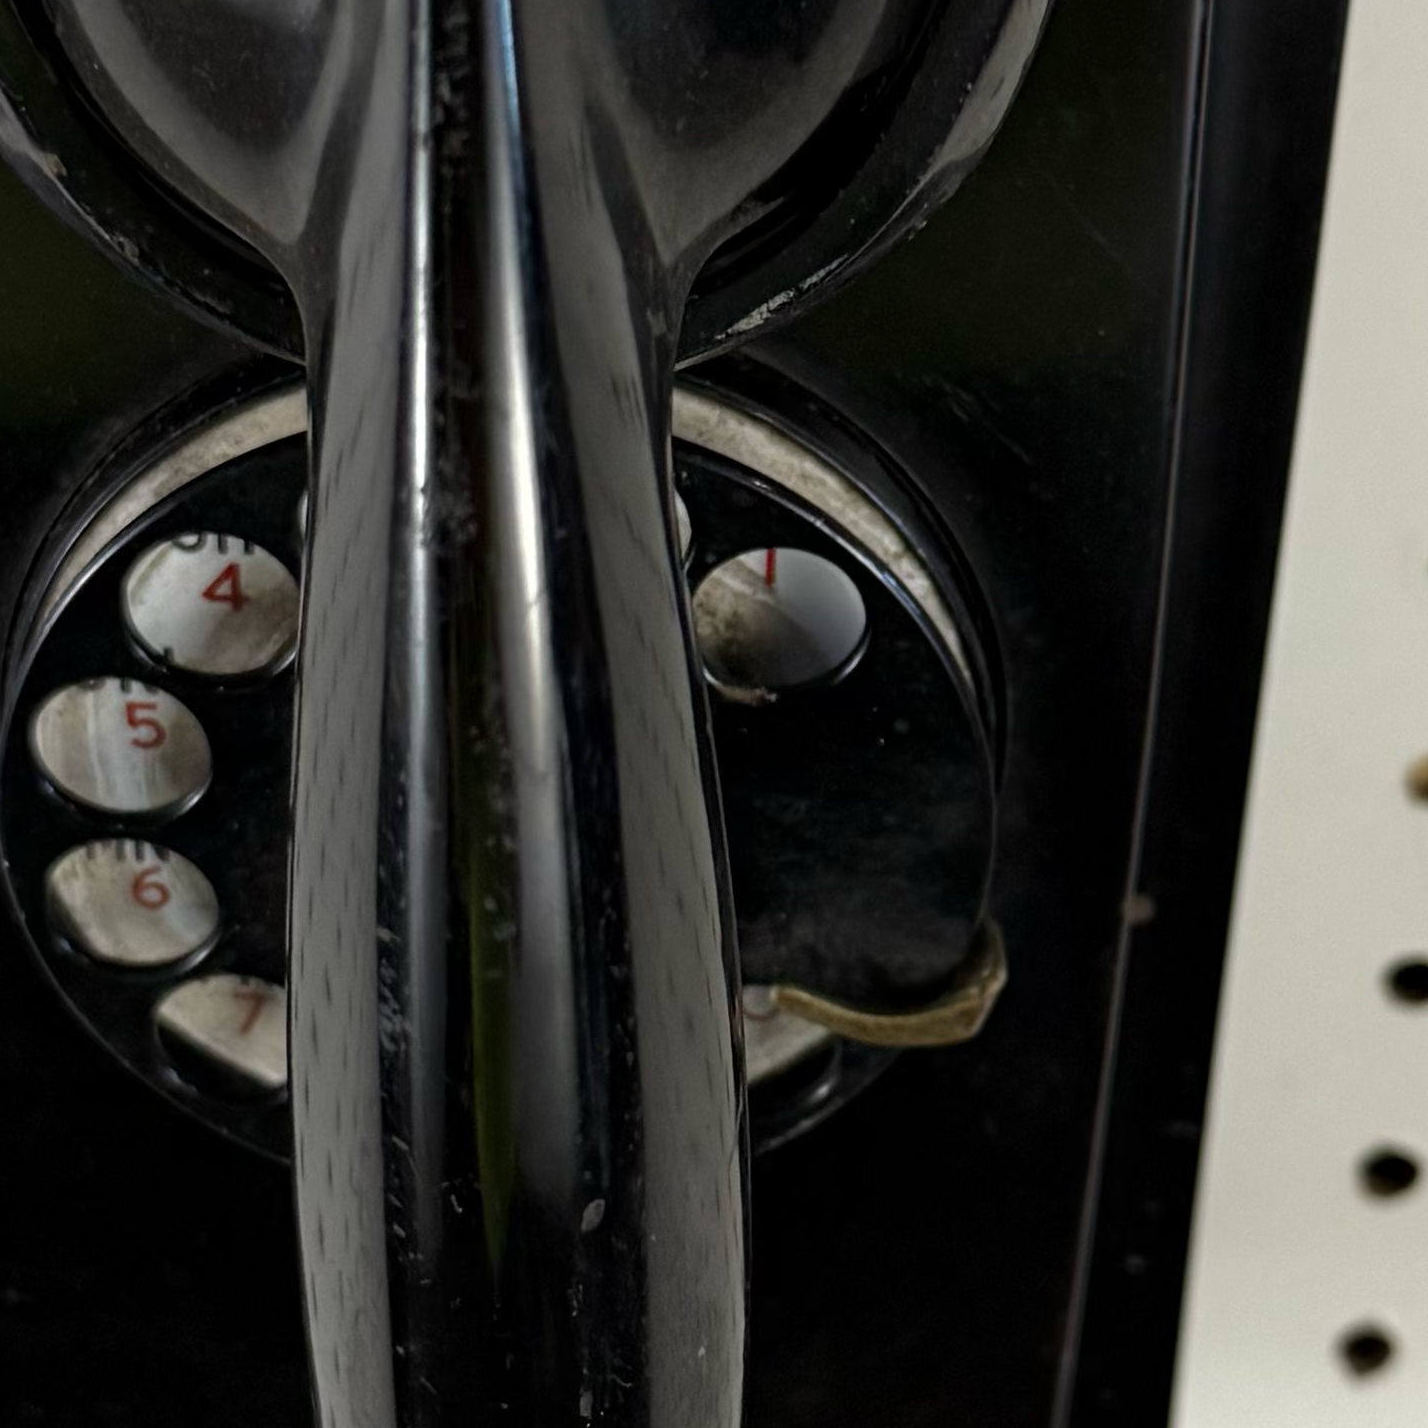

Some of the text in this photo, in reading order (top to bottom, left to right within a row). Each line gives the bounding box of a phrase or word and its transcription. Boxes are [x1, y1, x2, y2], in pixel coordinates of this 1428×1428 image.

[202, 562, 250, 612] 4
[125, 702, 166, 749] 5
[132, 865, 169, 910] 6
[233, 988, 273, 1036] 7
